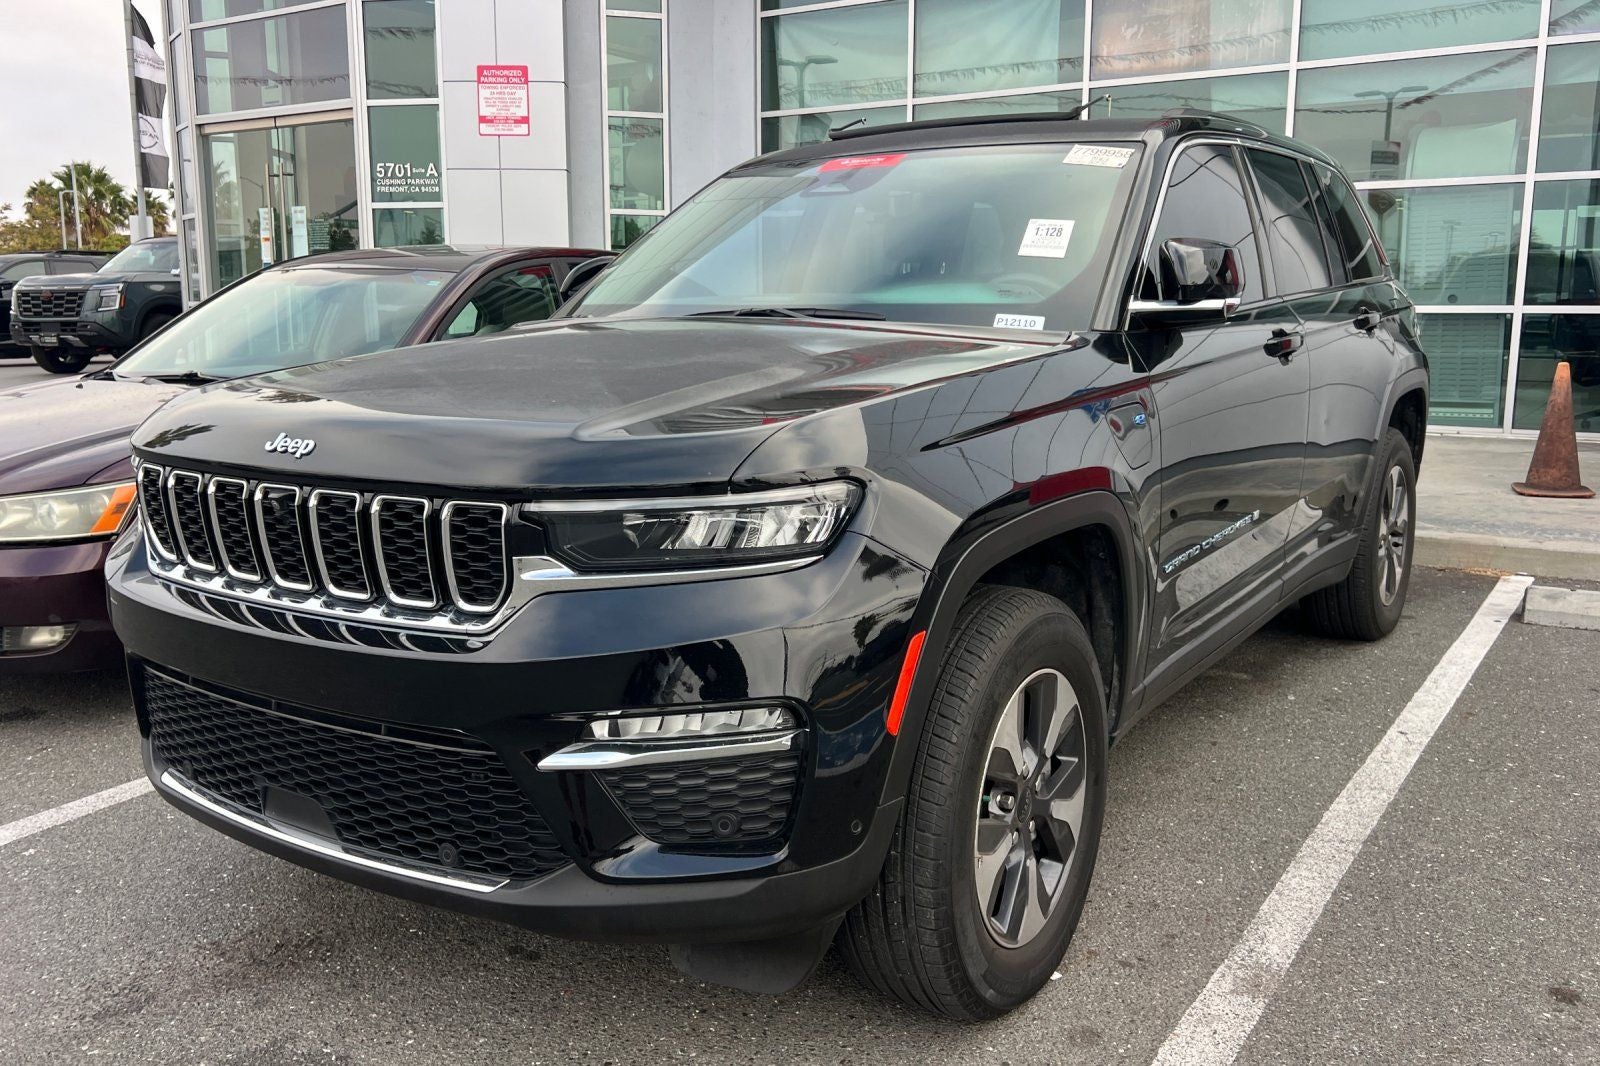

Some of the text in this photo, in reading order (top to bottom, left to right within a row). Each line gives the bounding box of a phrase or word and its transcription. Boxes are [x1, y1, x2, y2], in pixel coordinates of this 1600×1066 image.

[482, 69, 523, 77] AUTHORIZED
[1074, 147, 1134, 158] 7799958
[376, 162, 411, 178] 5701
[426, 162, 439, 177] A
[1035, 227, 1063, 237] 1:128
[996, 317, 1036, 328] P12110
[264, 432, 316, 459] Jeep
[1162, 513, 1253, 573] GRAND CHEROKEE
